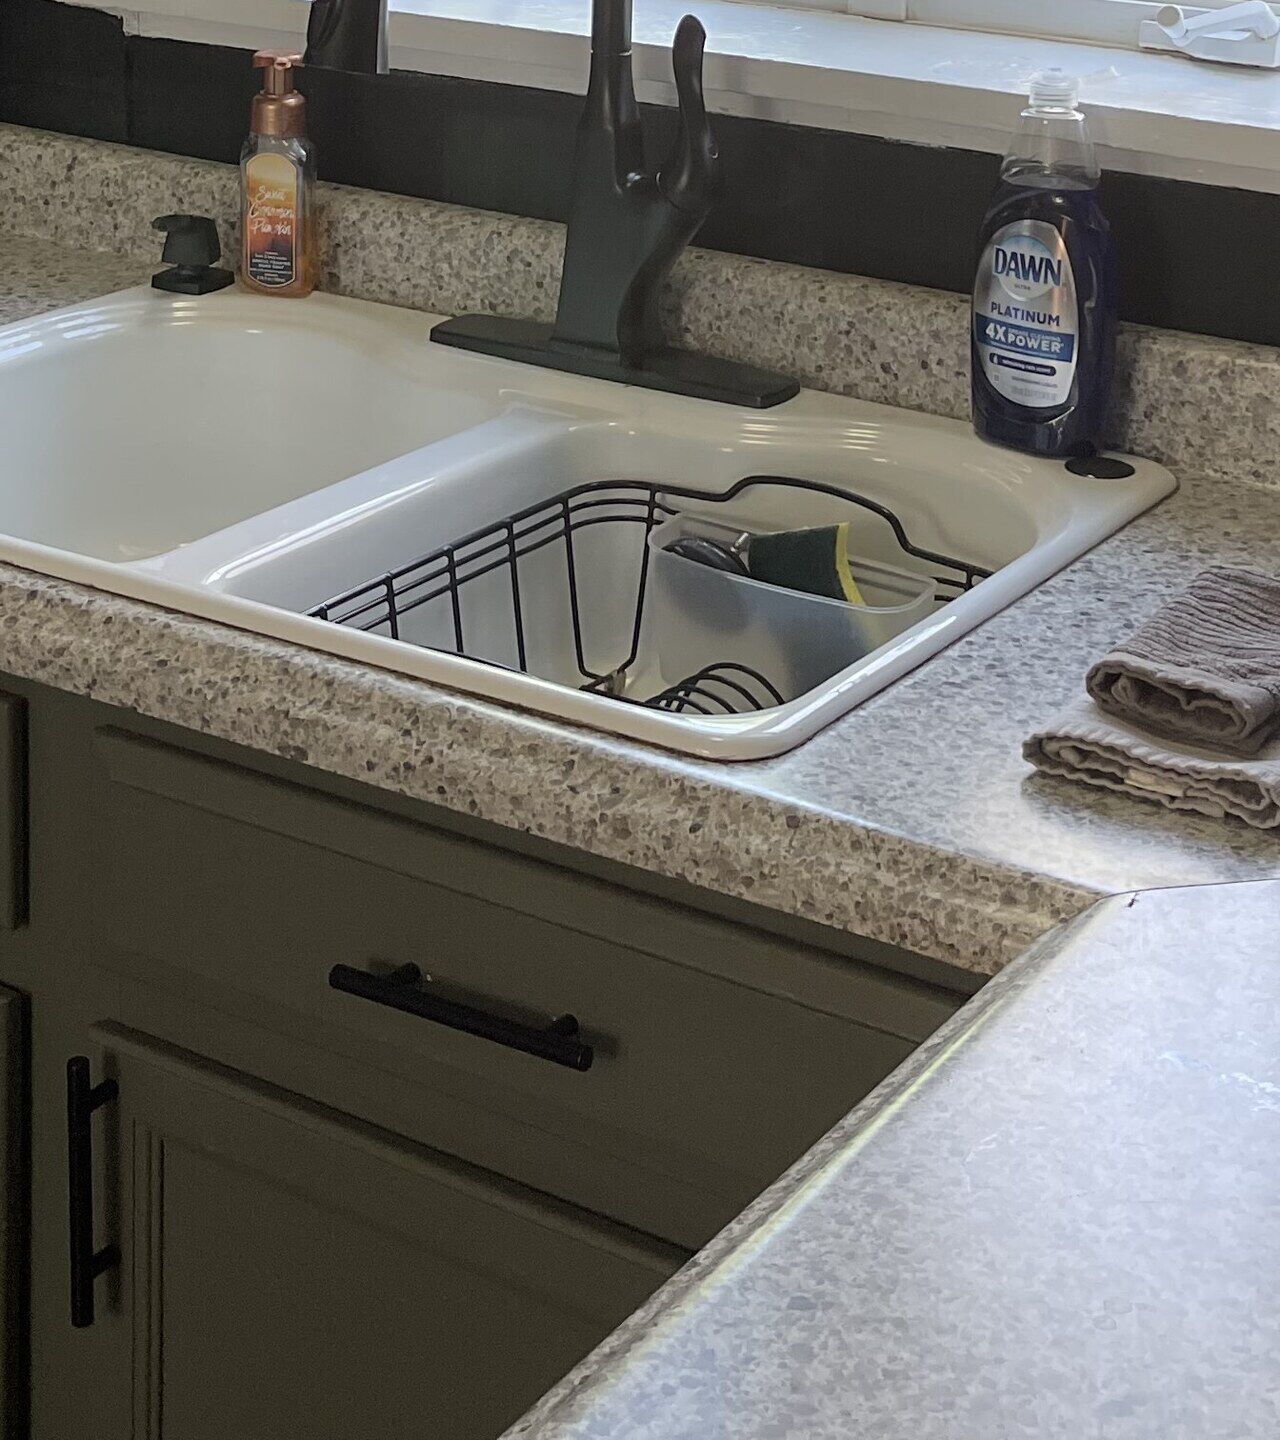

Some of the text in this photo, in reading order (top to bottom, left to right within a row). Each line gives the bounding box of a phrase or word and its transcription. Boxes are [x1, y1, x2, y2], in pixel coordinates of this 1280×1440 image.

[994, 247, 1062, 286] DAWN
[990, 301, 1060, 327] PLATINUM
[986, 322, 1006, 342] 4X
[1008, 333, 1061, 353] POWER
